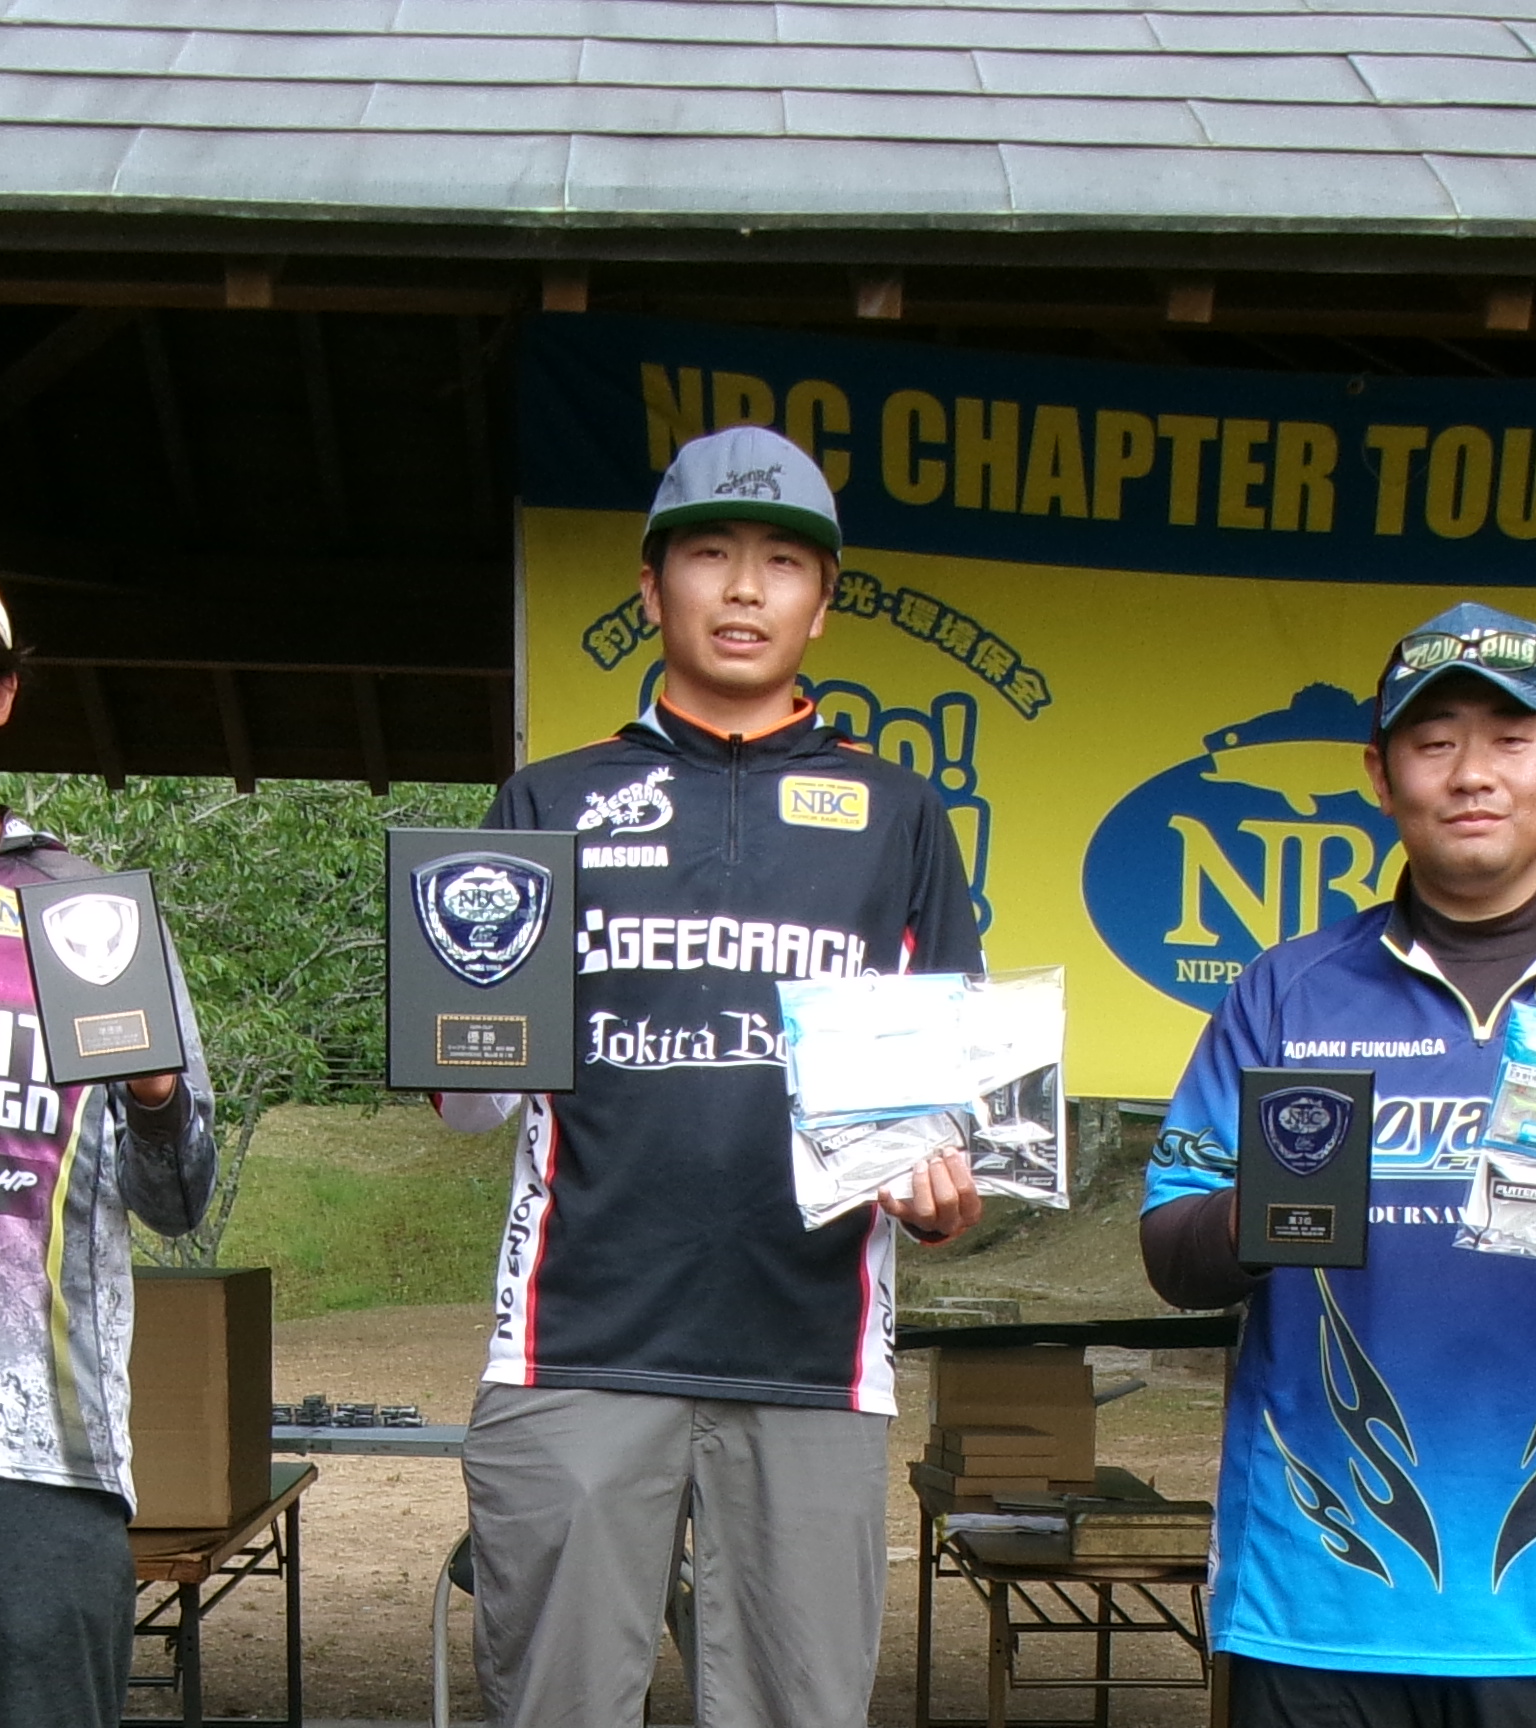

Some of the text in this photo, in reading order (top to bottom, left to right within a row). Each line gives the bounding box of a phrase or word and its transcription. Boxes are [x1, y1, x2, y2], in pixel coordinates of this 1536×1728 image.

[881, 389, 1338, 534] CHAPTER
[790, 789, 860, 817] NBC
[582, 846, 669, 869] MASUDA
[1350, 1038, 1447, 1058] FUKUNAGA
